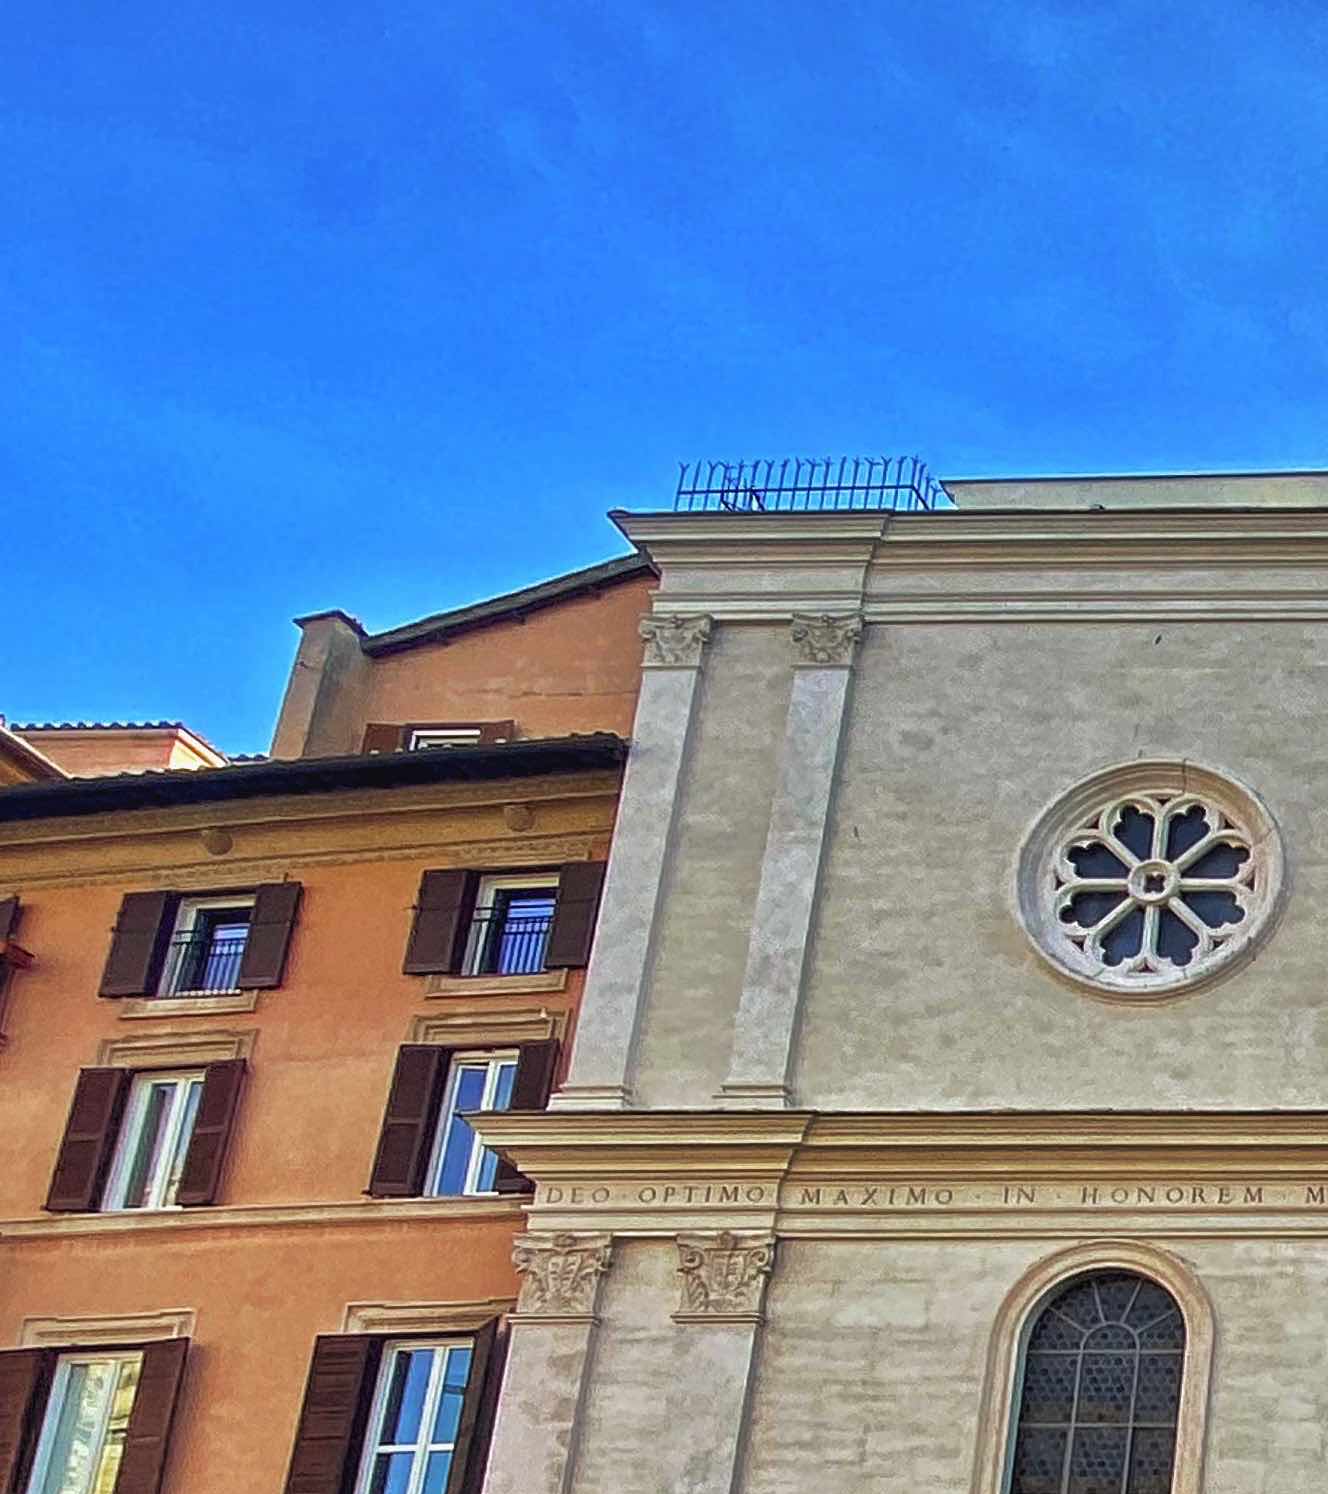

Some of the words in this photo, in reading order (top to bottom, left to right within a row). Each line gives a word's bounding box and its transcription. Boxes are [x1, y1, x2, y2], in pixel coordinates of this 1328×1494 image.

[545, 1186, 612, 1205] DEO
[638, 1185, 767, 1205] OPTIMO
[800, 1187, 955, 1206] MAXIMO
[1001, 1186, 1036, 1205] IN
[1079, 1186, 1264, 1206] HONOREM
